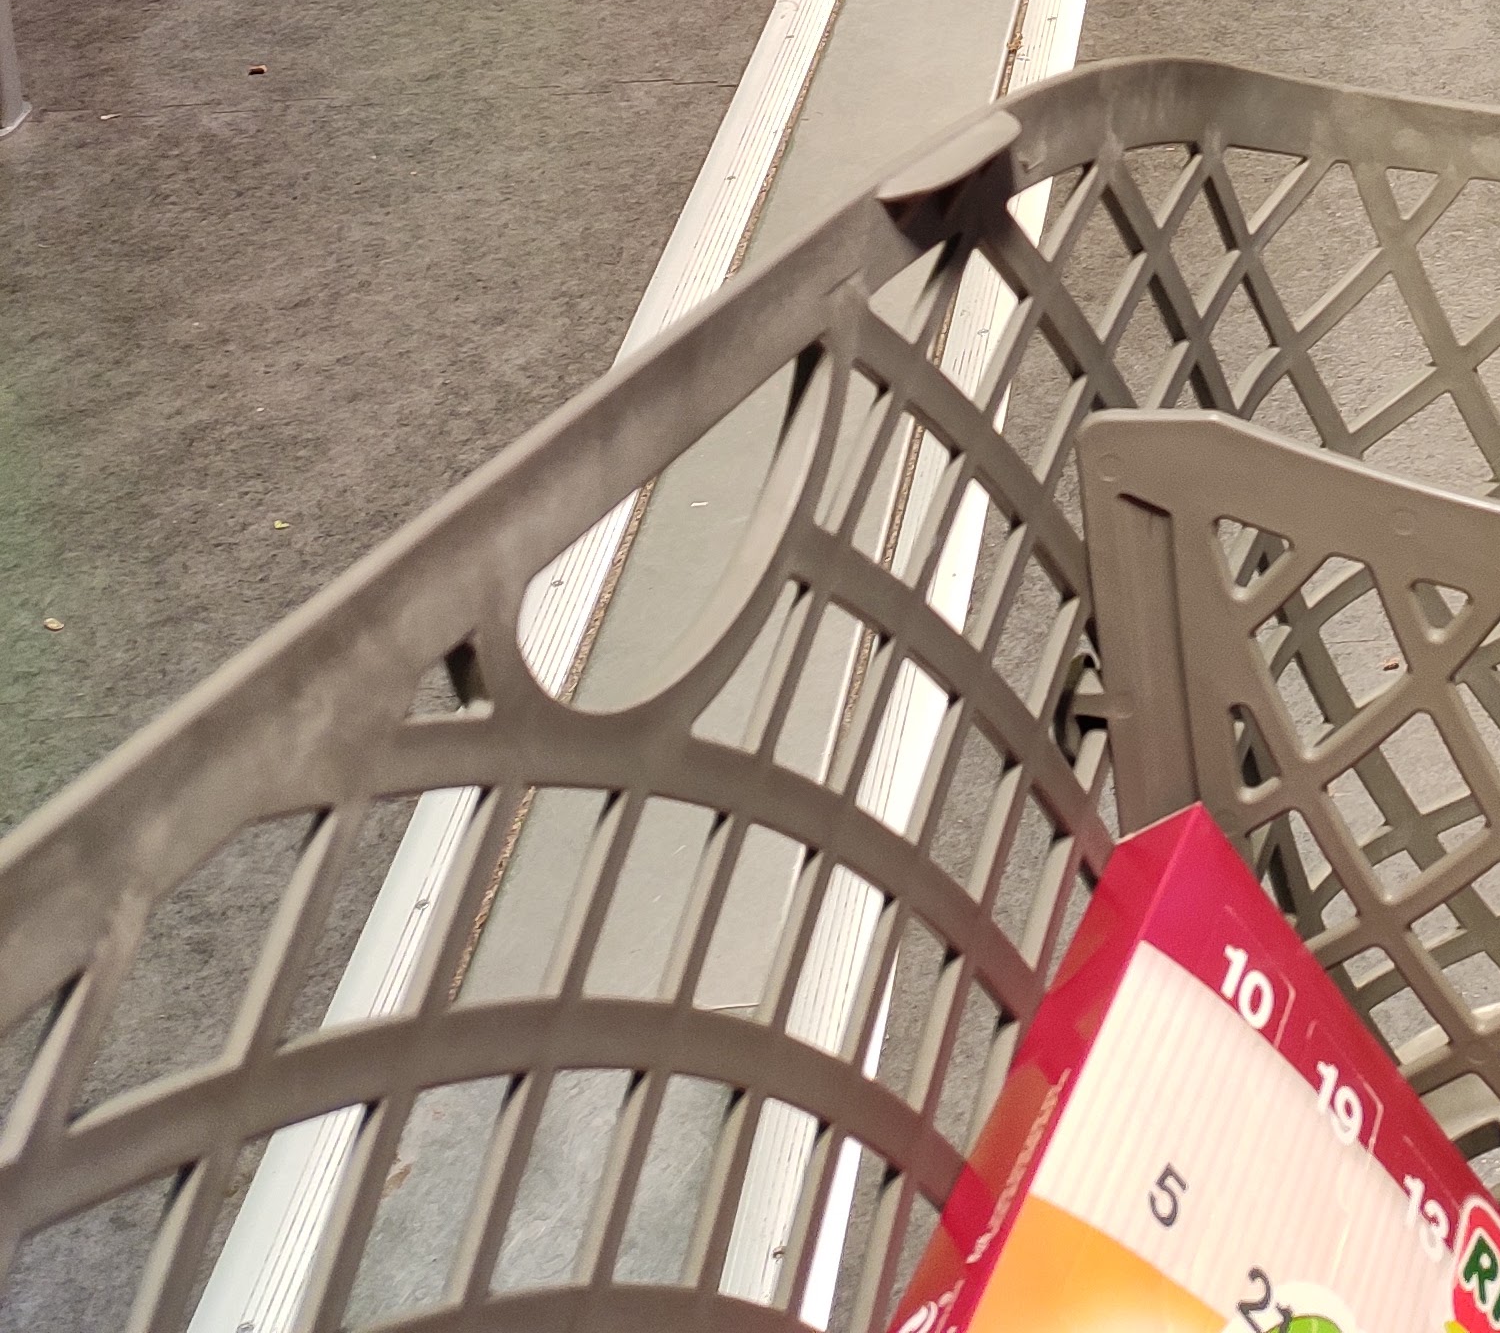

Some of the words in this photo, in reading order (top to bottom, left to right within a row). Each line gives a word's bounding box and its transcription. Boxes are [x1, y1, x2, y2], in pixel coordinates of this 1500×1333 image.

[1222, 944, 1275, 1031] 10
[1316, 1060, 1365, 1146] 19
[1148, 1162, 1190, 1228] 5
[1403, 1174, 1450, 1263] 13
